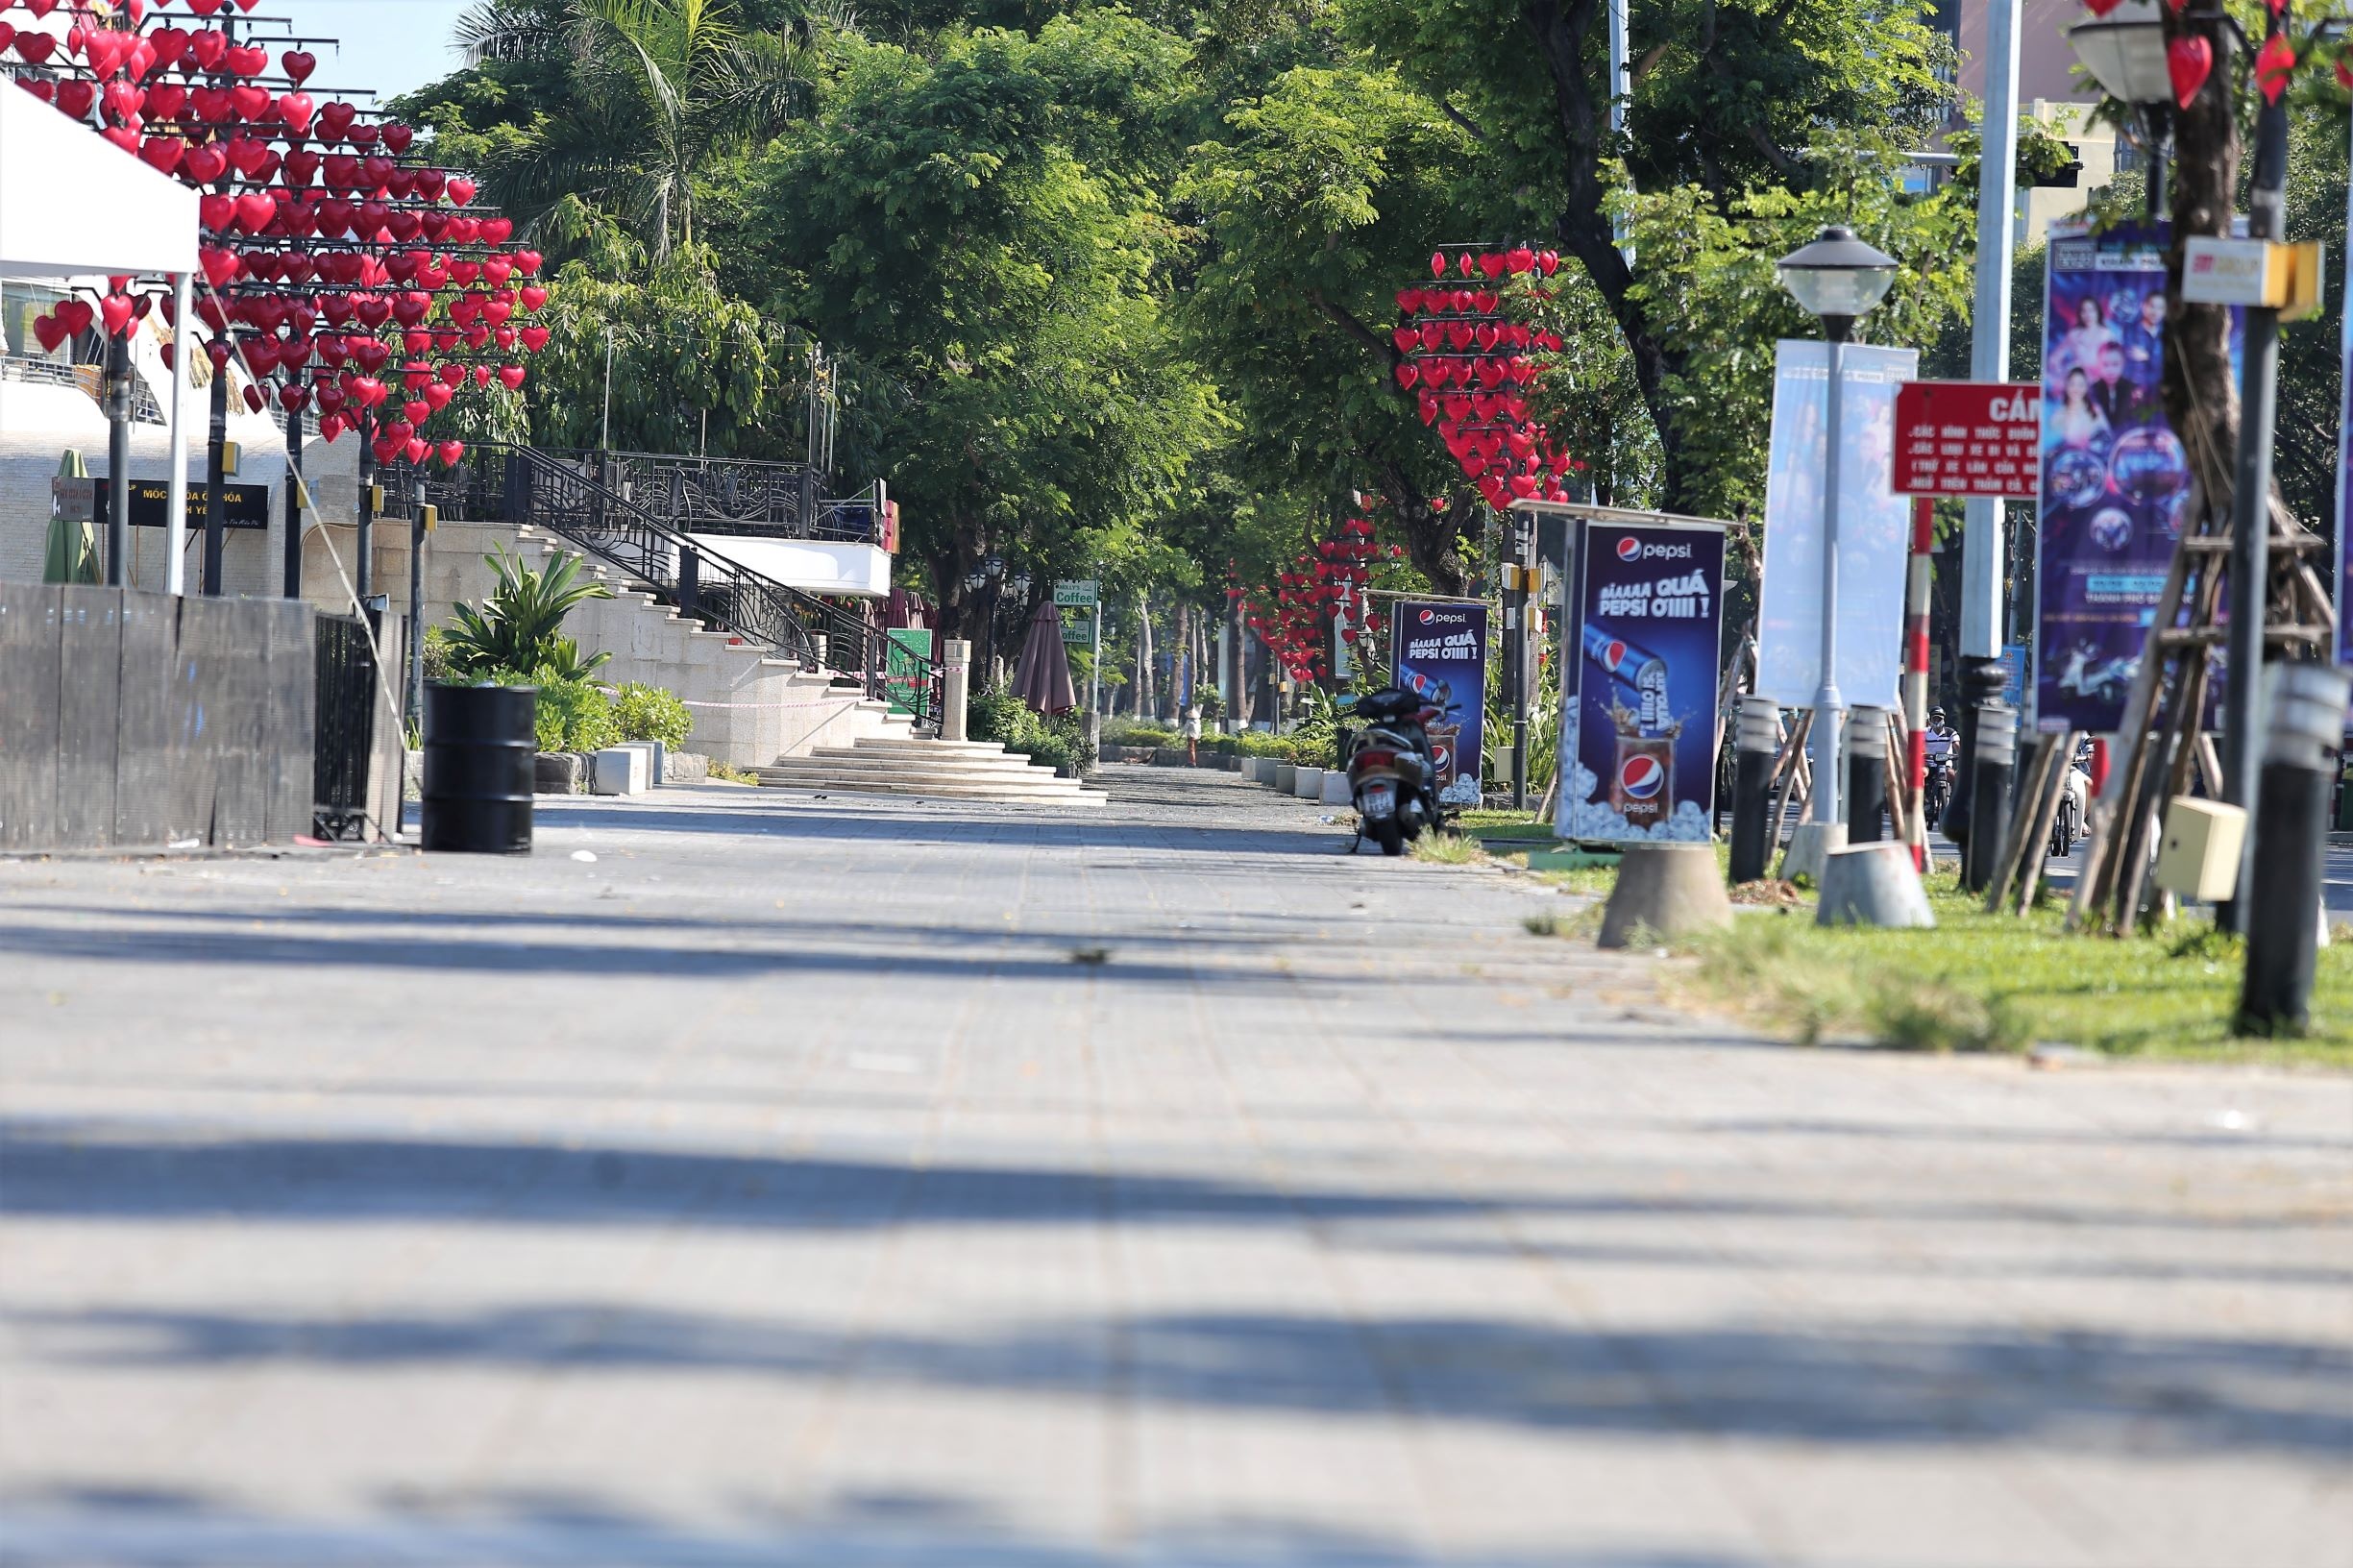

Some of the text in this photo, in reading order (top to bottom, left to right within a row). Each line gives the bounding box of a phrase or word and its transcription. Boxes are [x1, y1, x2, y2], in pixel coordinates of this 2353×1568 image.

[143, 487, 167, 500] MÓC
[223, 490, 242, 502] HÓA
[1643, 543, 1691, 560] pepsi
[1656, 568, 1709, 597] QUÁ
[1056, 592, 1092, 603] Coffee
[1600, 598, 1648, 617] PEPSI
[1700, 597, 1710, 618] !
[1435, 613, 1465, 625] pepsi
[1063, 630, 1087, 641] offee
[1444, 629, 1477, 647] QUÁ
[1409, 648, 1439, 659] PEPSI
[1471, 647, 1478, 660] !
[1623, 802, 1658, 815] pepsi
